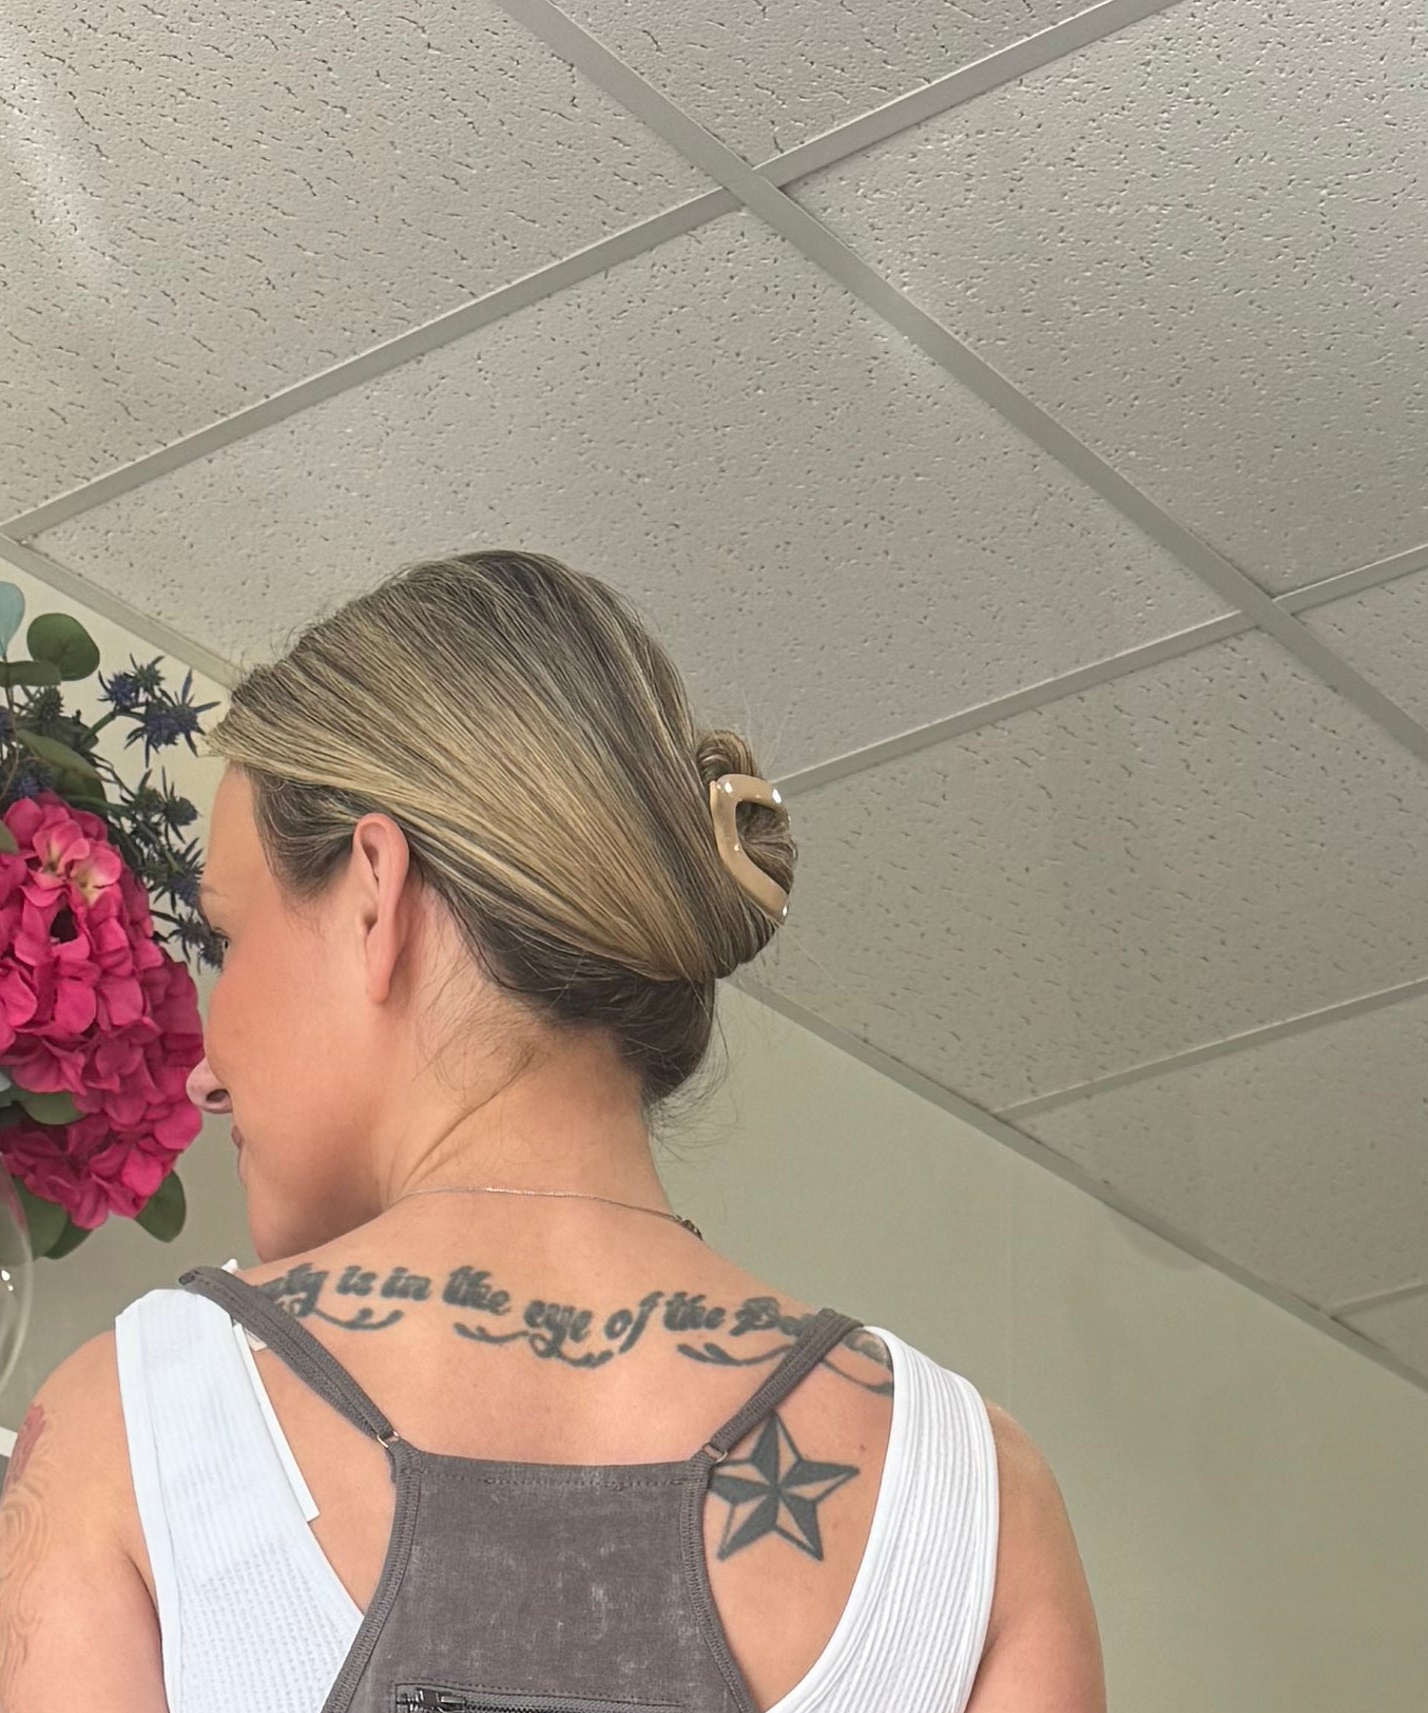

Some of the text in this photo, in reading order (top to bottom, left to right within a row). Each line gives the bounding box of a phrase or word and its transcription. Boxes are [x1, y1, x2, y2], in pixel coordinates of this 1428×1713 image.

[381, 1266, 432, 1301] in
[442, 1265, 512, 1316] the
[524, 1299, 594, 1358] eye
[603, 1290, 665, 1354] of
[663, 1291, 726, 1332] the
